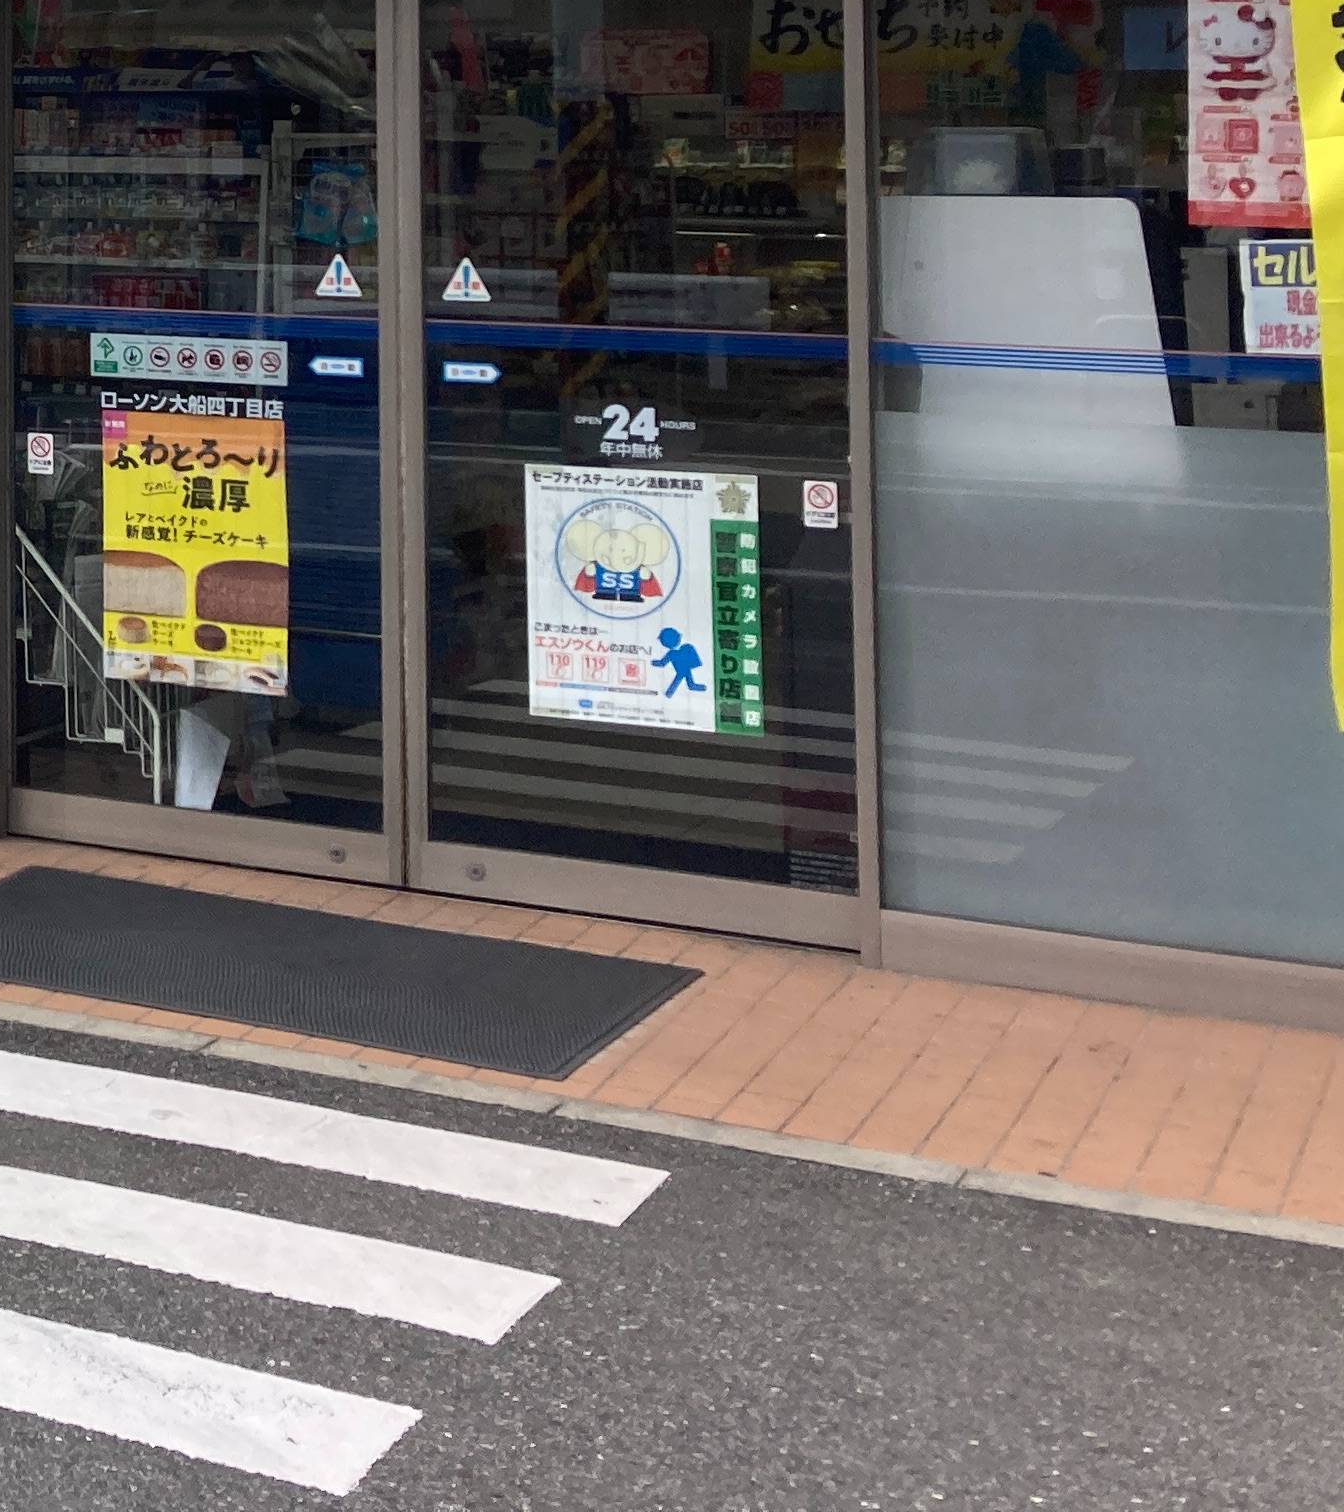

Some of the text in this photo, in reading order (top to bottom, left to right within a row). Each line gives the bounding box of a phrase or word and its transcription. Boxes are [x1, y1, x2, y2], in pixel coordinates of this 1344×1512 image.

[1258, 324, 1321, 350] 出来るよ
[100, 391, 284, 420] ローソン大船四丁目店
[574, 403, 697, 442] OPEN 24 HOURS
[599, 440, 664, 460] 年中無休
[182, 475, 250, 513] 濃厚
[125, 512, 208, 526] レアとベイクドの
[601, 572, 635, 589] SS
[549, 654, 570, 666] 110
[584, 657, 606, 670] 119
